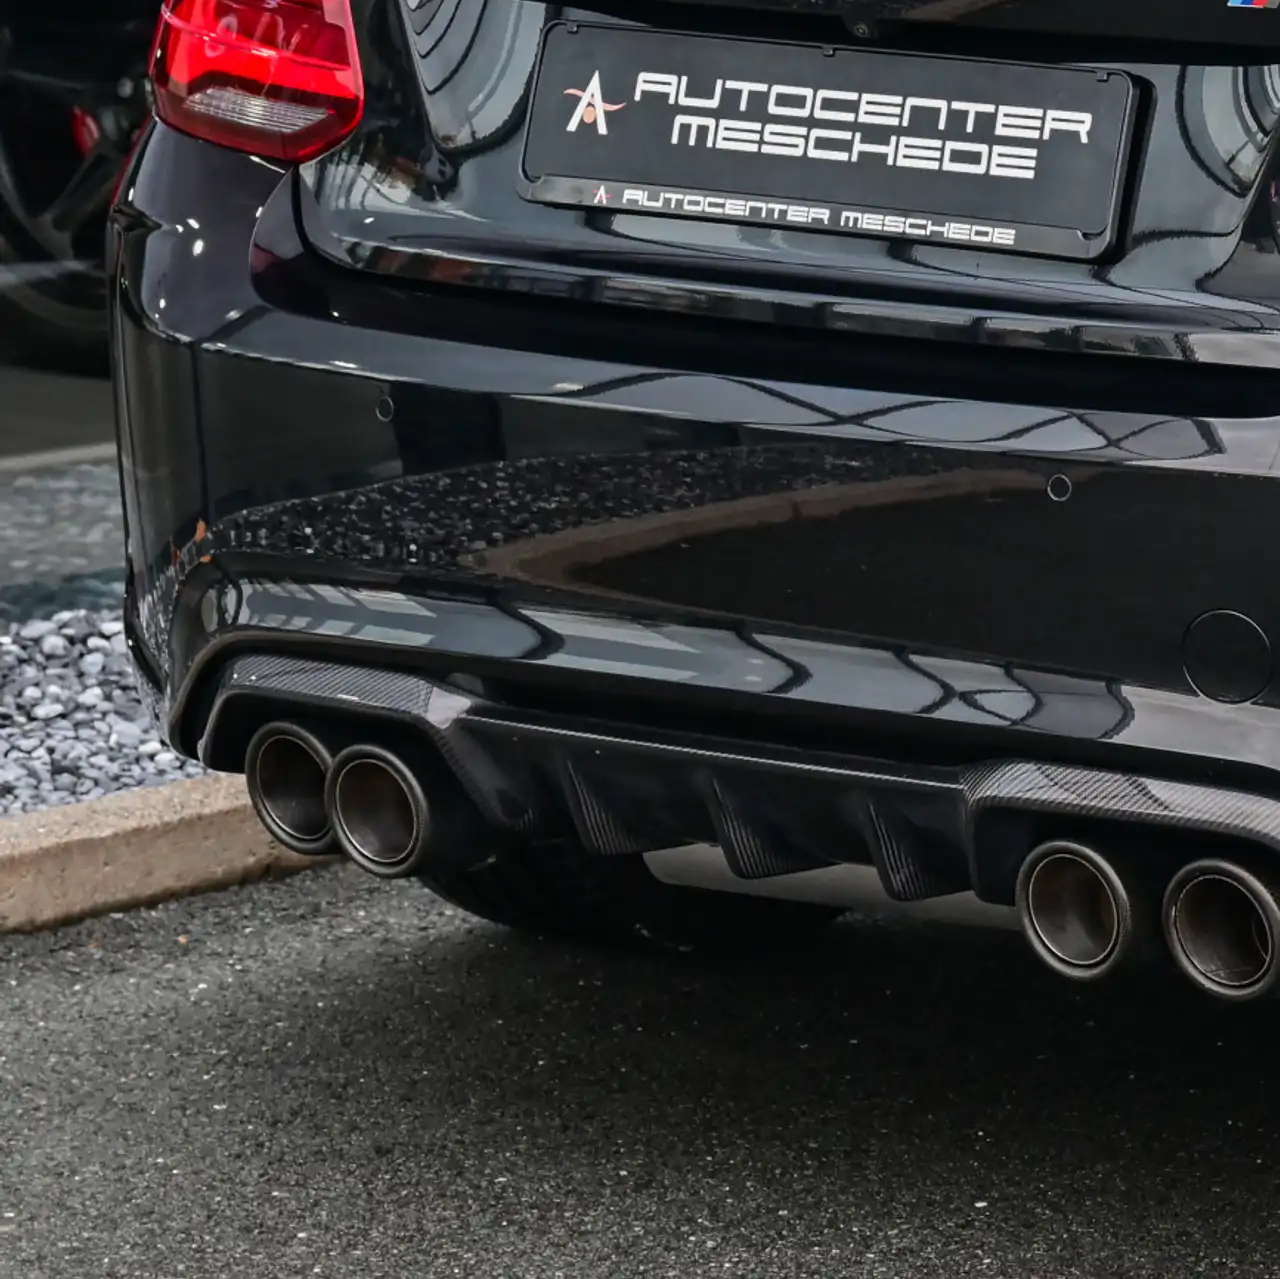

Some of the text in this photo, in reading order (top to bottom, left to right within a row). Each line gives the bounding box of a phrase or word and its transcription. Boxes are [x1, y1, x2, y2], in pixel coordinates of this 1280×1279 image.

[634, 72, 1092, 144] AUTOCENTER
[671, 115, 1038, 180] MESCHEDE
[622, 188, 1016, 246] AUTOCENTER MESCHEDE
